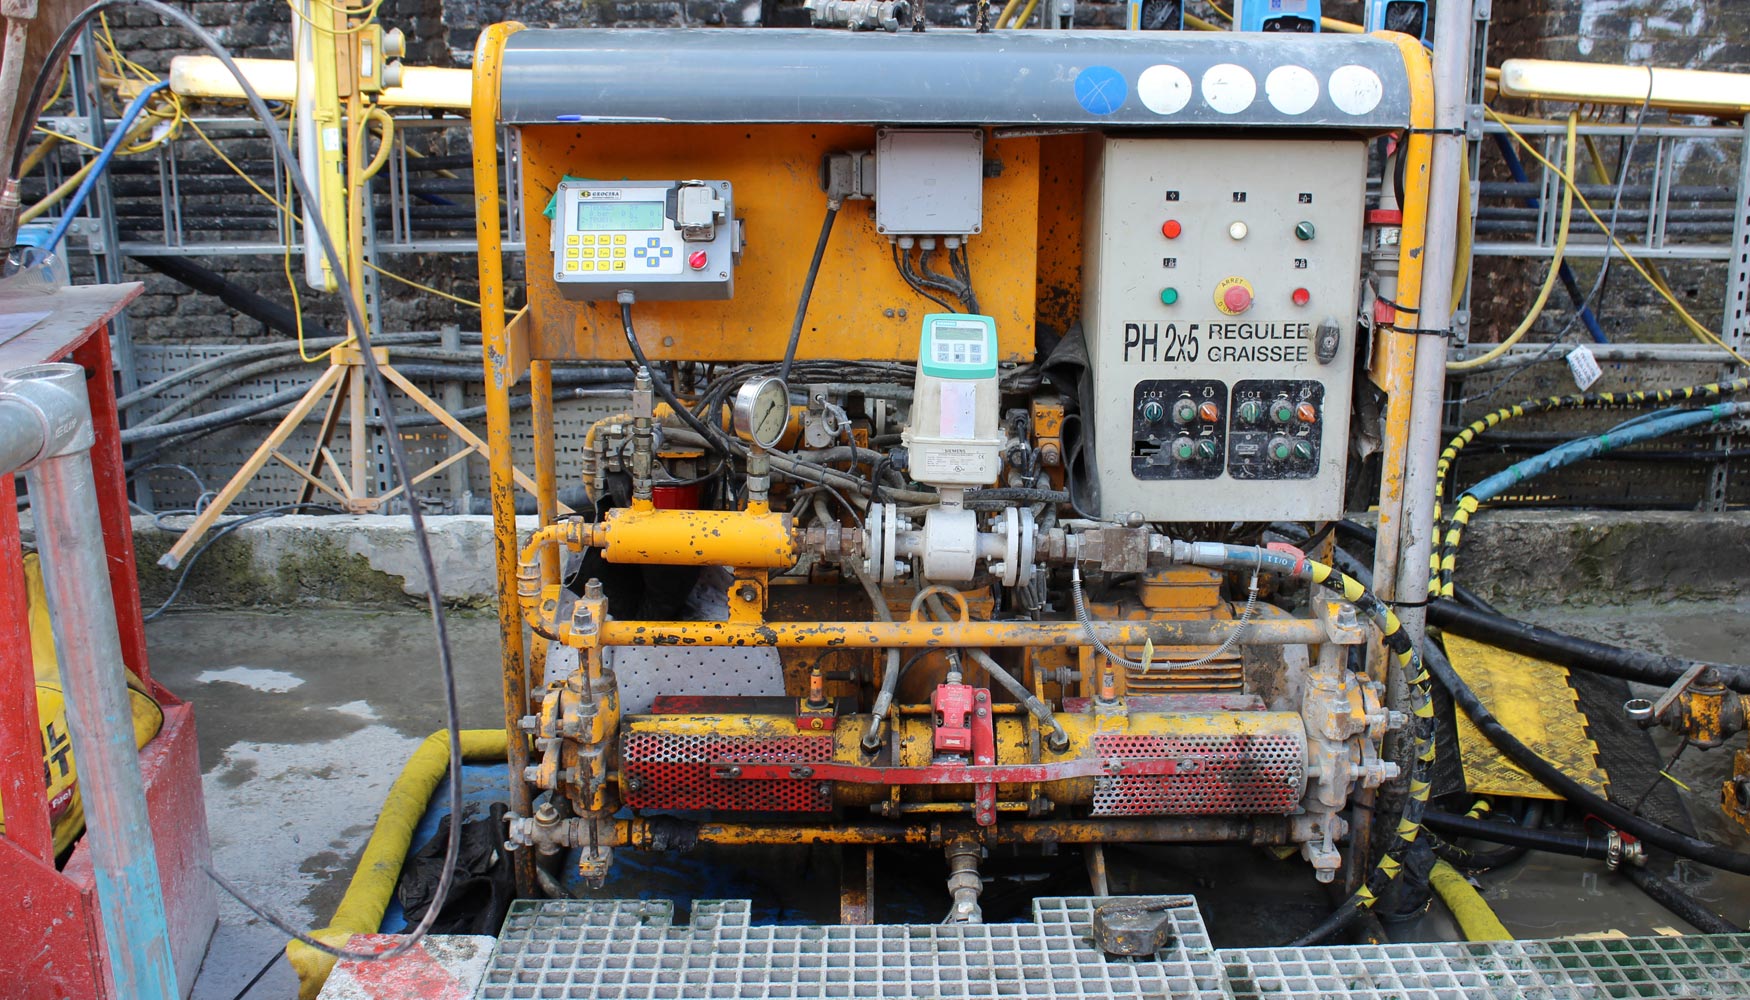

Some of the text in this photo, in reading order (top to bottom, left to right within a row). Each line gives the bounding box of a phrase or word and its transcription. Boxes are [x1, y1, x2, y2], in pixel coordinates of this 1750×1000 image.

[1221, 277, 1244, 288] ARRET
[1208, 324, 1310, 339] REGULEE
[1124, 323, 1199, 362] PH 2x5
[1207, 346, 1308, 362] GRAISSEE
[52, 789, 72, 807] Fuel
